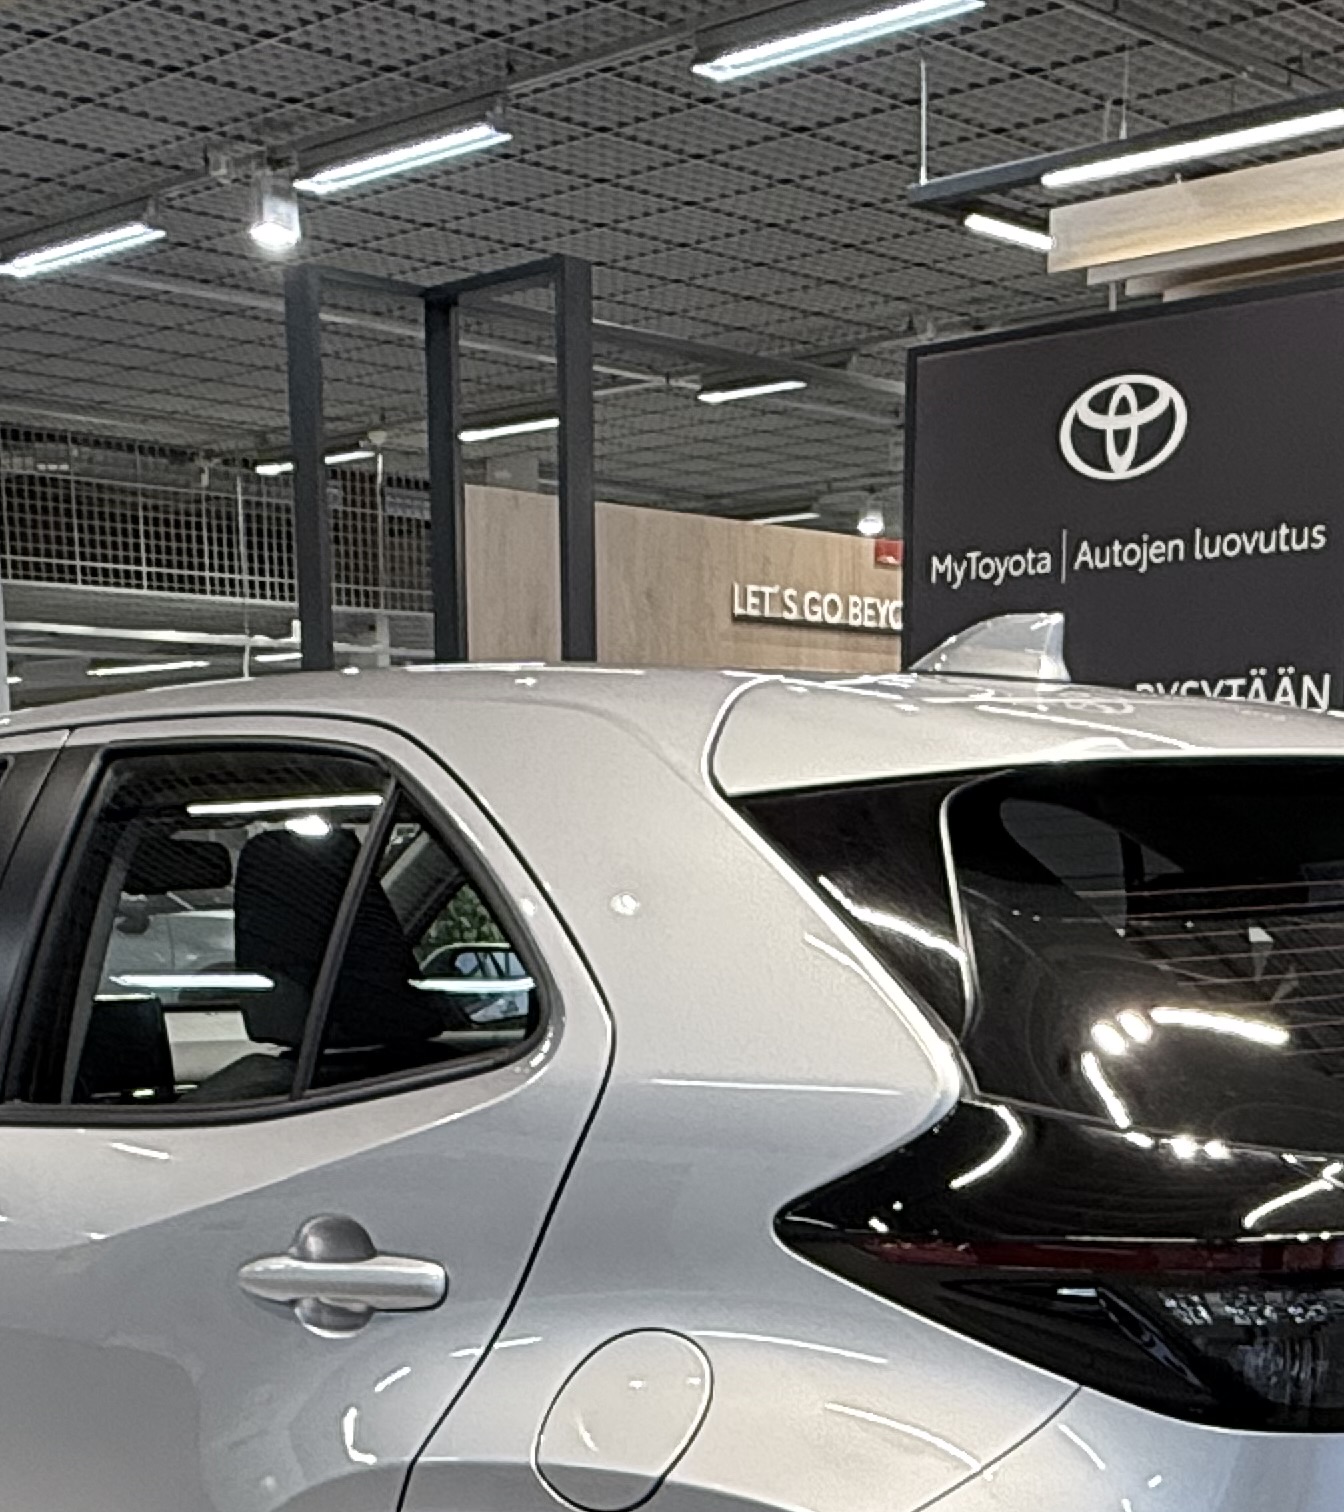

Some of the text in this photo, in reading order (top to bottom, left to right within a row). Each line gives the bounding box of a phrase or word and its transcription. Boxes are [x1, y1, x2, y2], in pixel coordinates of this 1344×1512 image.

[929, 522, 1327, 589] MyToyota Autojen luovutus
[803, 590, 843, 624] GO
